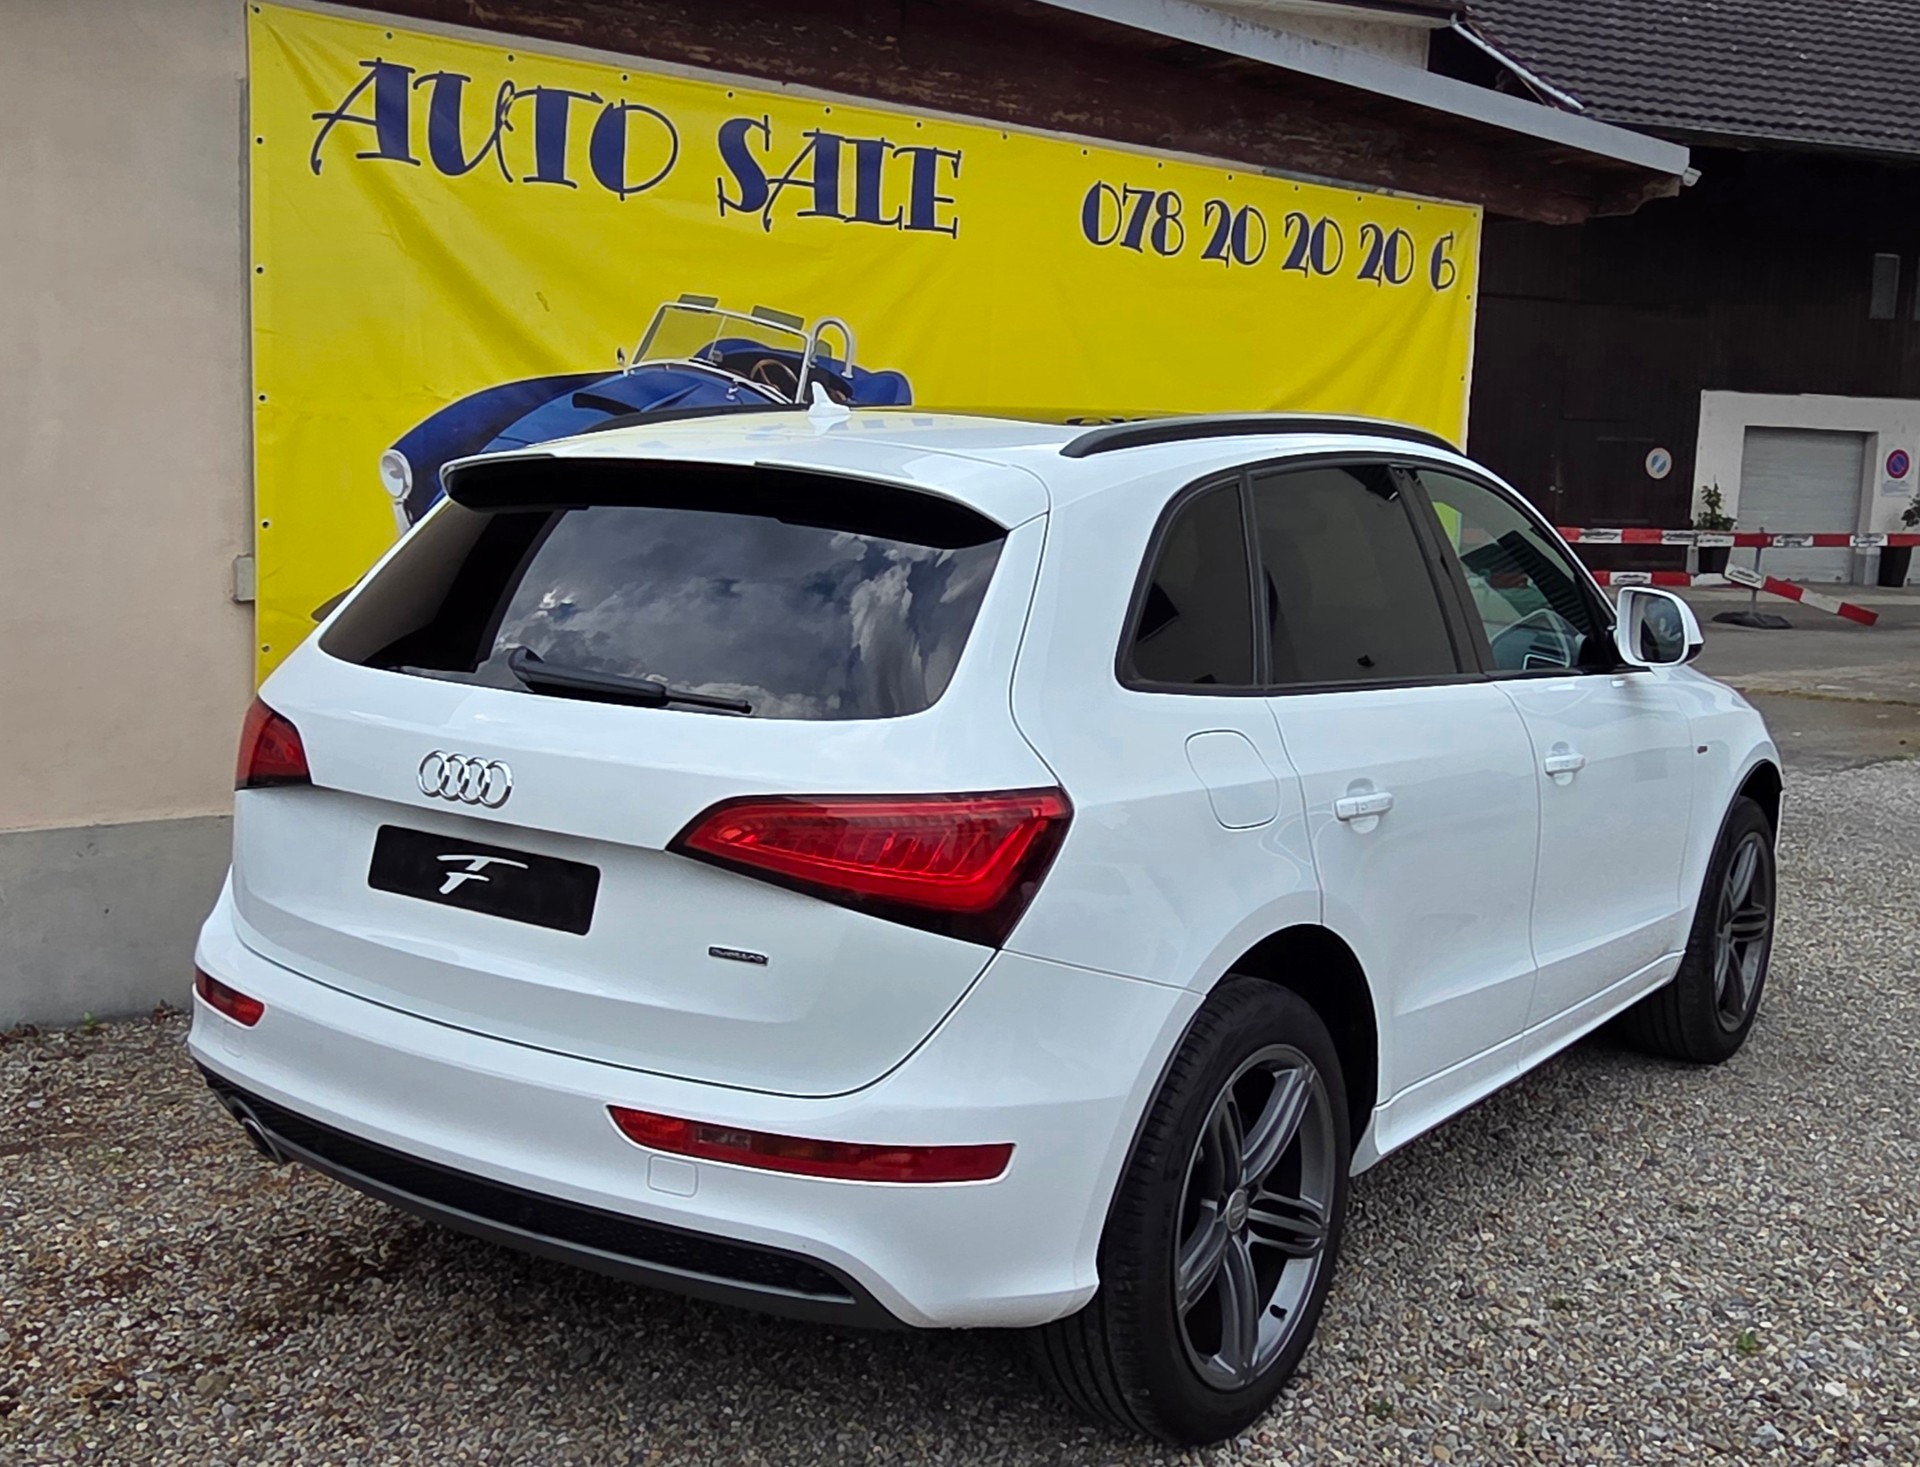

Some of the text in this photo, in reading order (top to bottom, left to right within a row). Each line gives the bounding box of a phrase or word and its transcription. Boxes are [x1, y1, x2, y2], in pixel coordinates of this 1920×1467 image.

[311, 57, 962, 240] AUTO SALE
[1082, 180, 1456, 291] 078 20 20 20 6
